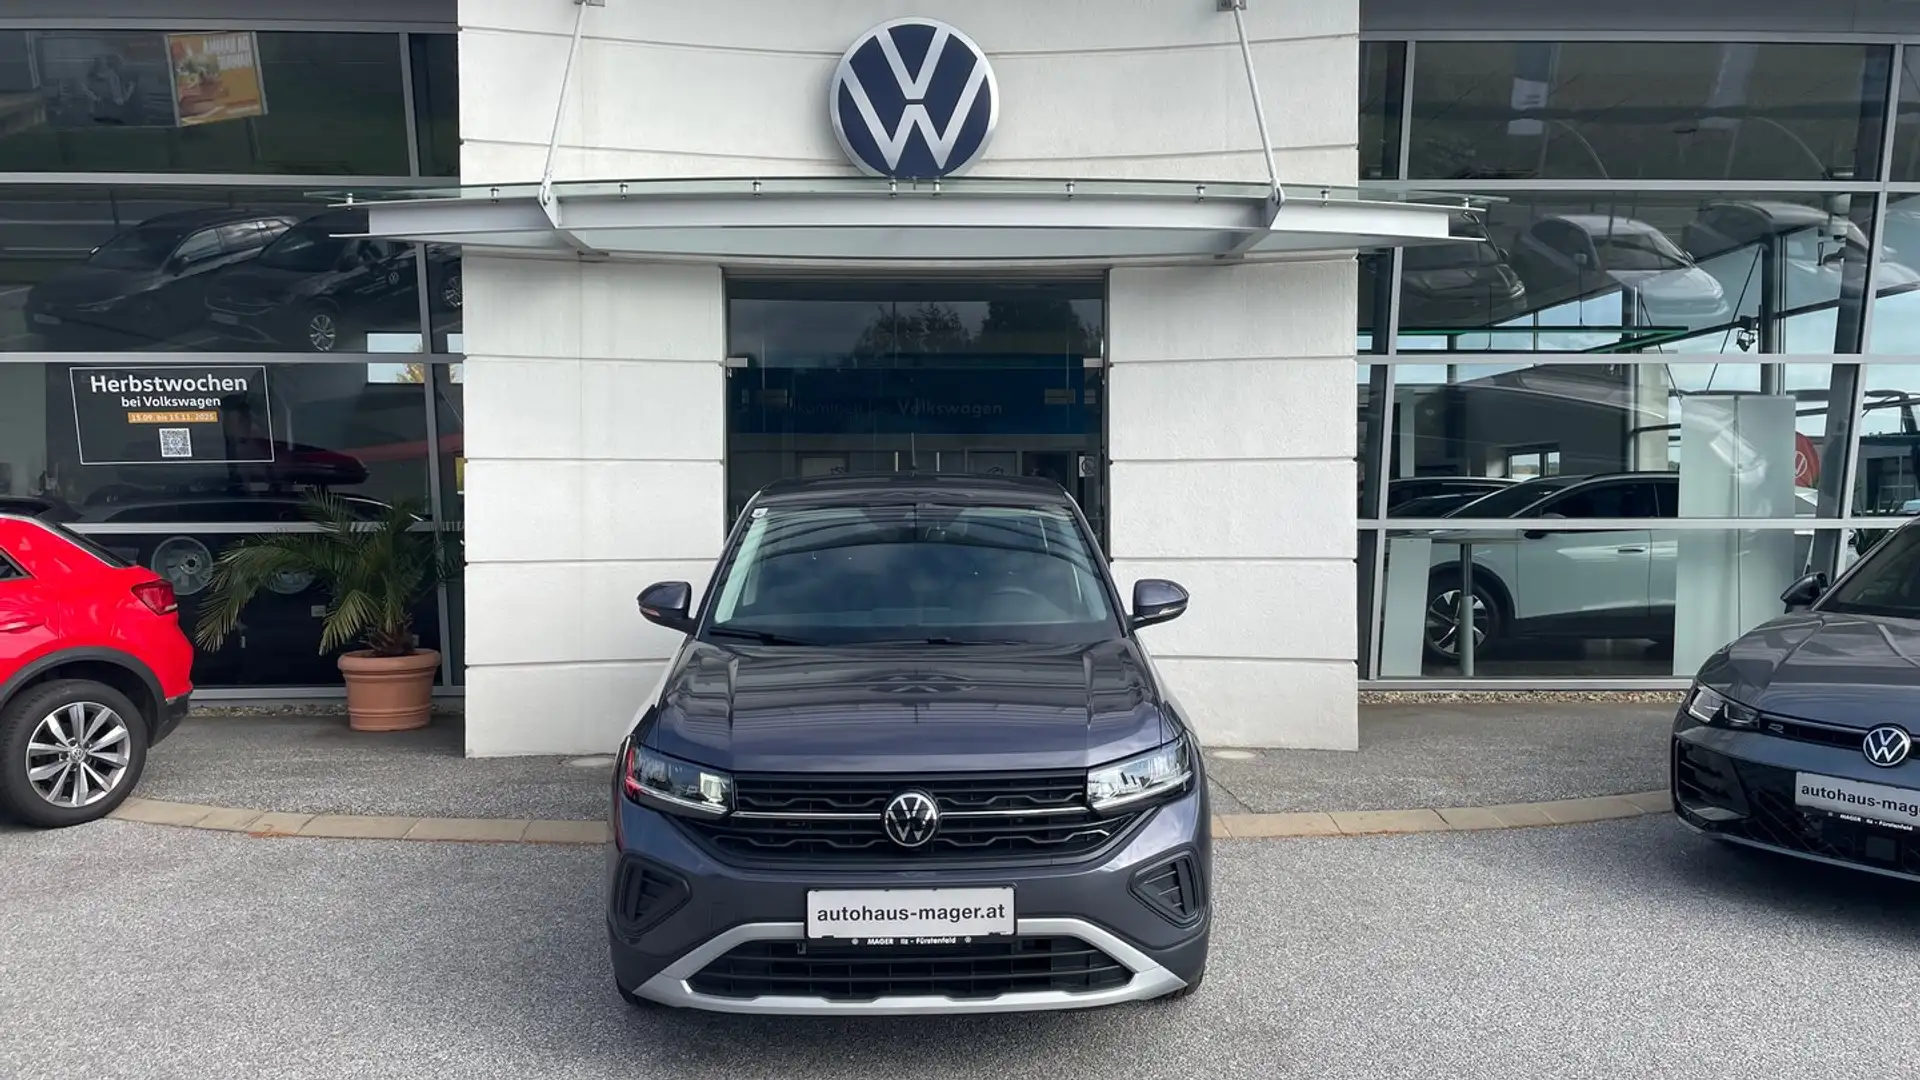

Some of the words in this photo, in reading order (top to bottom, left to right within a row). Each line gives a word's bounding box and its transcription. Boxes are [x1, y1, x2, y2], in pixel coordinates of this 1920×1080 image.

[834, 20, 998, 178] VW
[90, 373, 248, 393] Herbstwochen
[121, 396, 141, 408] bei
[143, 396, 221, 409] Volkswagen
[896, 397, 1004, 418] Volkswagen
[1864, 726, 1910, 767] VW
[885, 792, 937, 847] VW
[817, 903, 1006, 922] autohaus-mager.at
[866, 936, 894, 945] MAGER
[915, 935, 957, 945] Fürstenfeld
